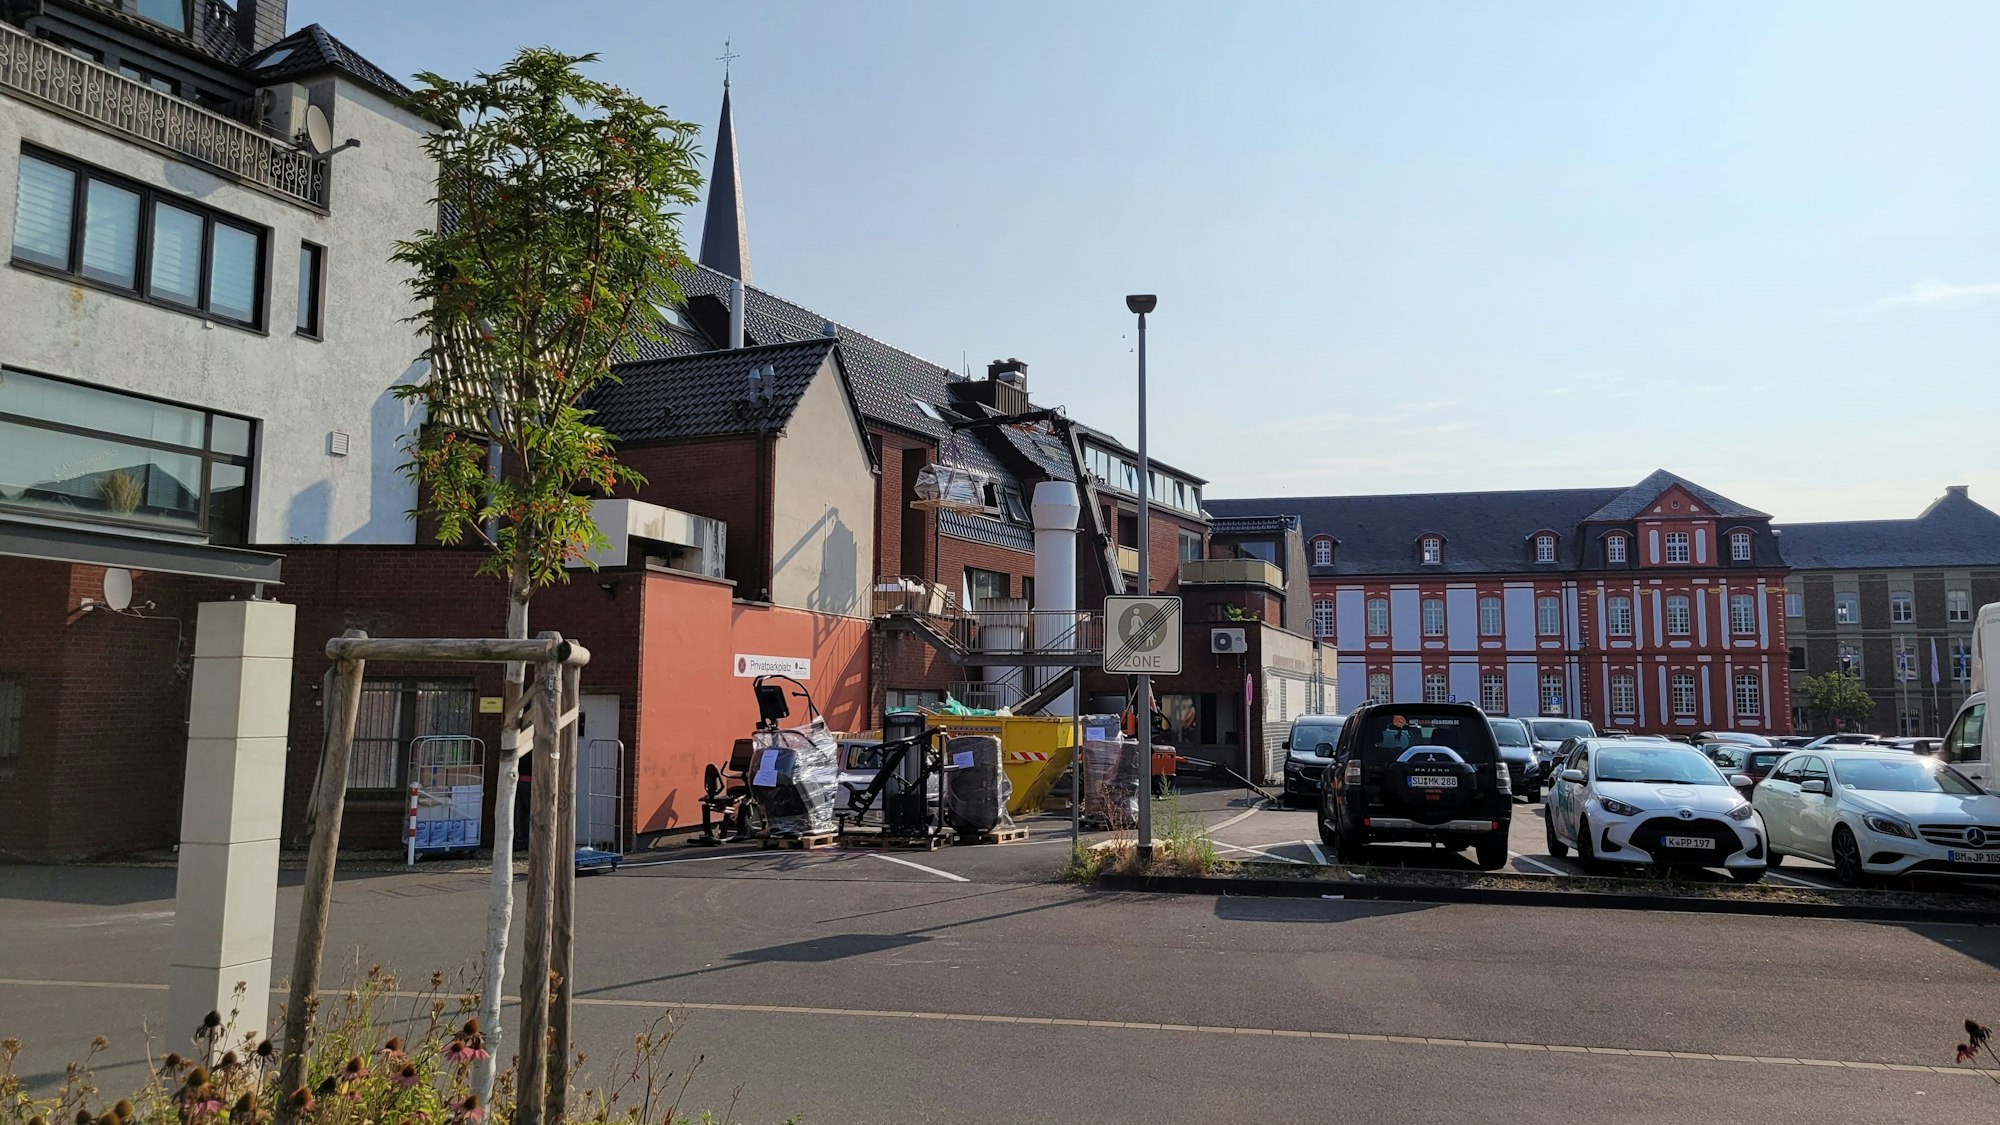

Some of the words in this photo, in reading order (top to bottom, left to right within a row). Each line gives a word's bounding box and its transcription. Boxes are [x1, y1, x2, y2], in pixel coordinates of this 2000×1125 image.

[750, 659, 792, 672] Privatparkplatz
[1124, 655, 1161, 668] ZONE
[1412, 776, 1424, 785] SU
[1441, 777, 1457, 786] 288
[1669, 838, 1675, 846] K
[1681, 839, 1692, 847] PP
[1694, 839, 1710, 848] 197
[1955, 852, 1967, 861] BM
[1973, 853, 1984, 862] JP
